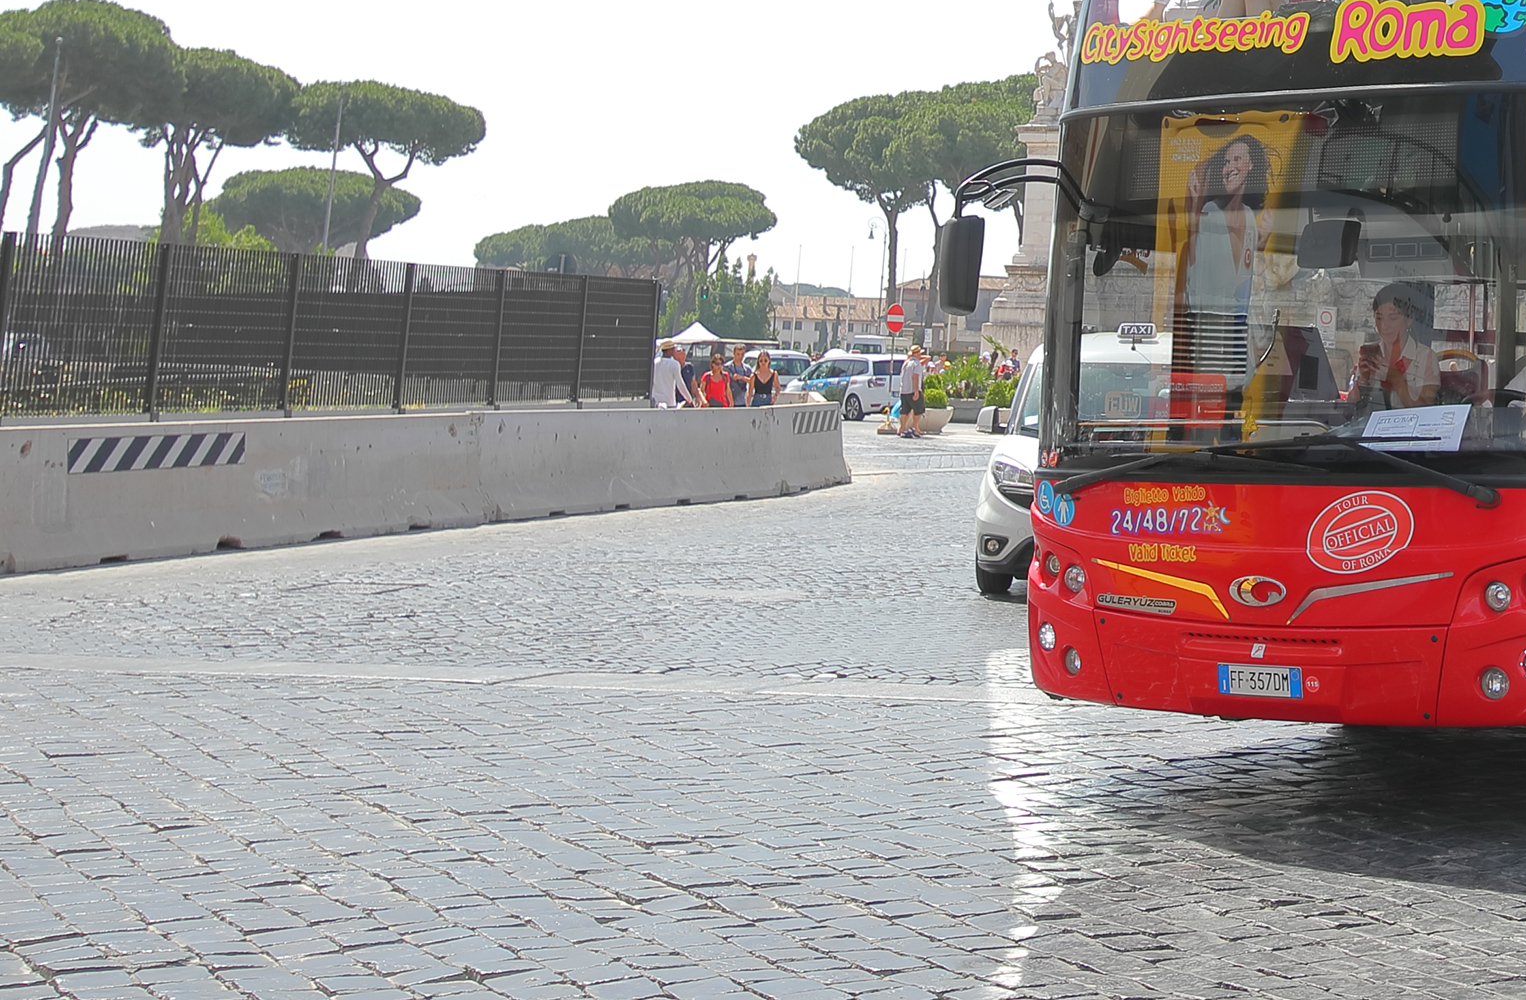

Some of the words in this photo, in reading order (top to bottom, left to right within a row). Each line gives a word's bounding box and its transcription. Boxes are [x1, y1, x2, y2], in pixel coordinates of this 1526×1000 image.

[1122, 325, 1152, 335] TAXI
[1124, 487, 1170, 506] Biglietto
[1171, 485, 1206, 502] Valido
[1335, 495, 1369, 513] TOUR
[1111, 506, 1203, 535] 24/48/72
[1325, 518, 1395, 550] OFFICIAL
[1128, 543, 1158, 562] Valid
[1160, 543, 1197, 562] Ticket
[1342, 560, 1357, 571] OF
[1359, 548, 1392, 569] ROMA
[1097, 592, 1155, 607] GÜLERYÜZ
